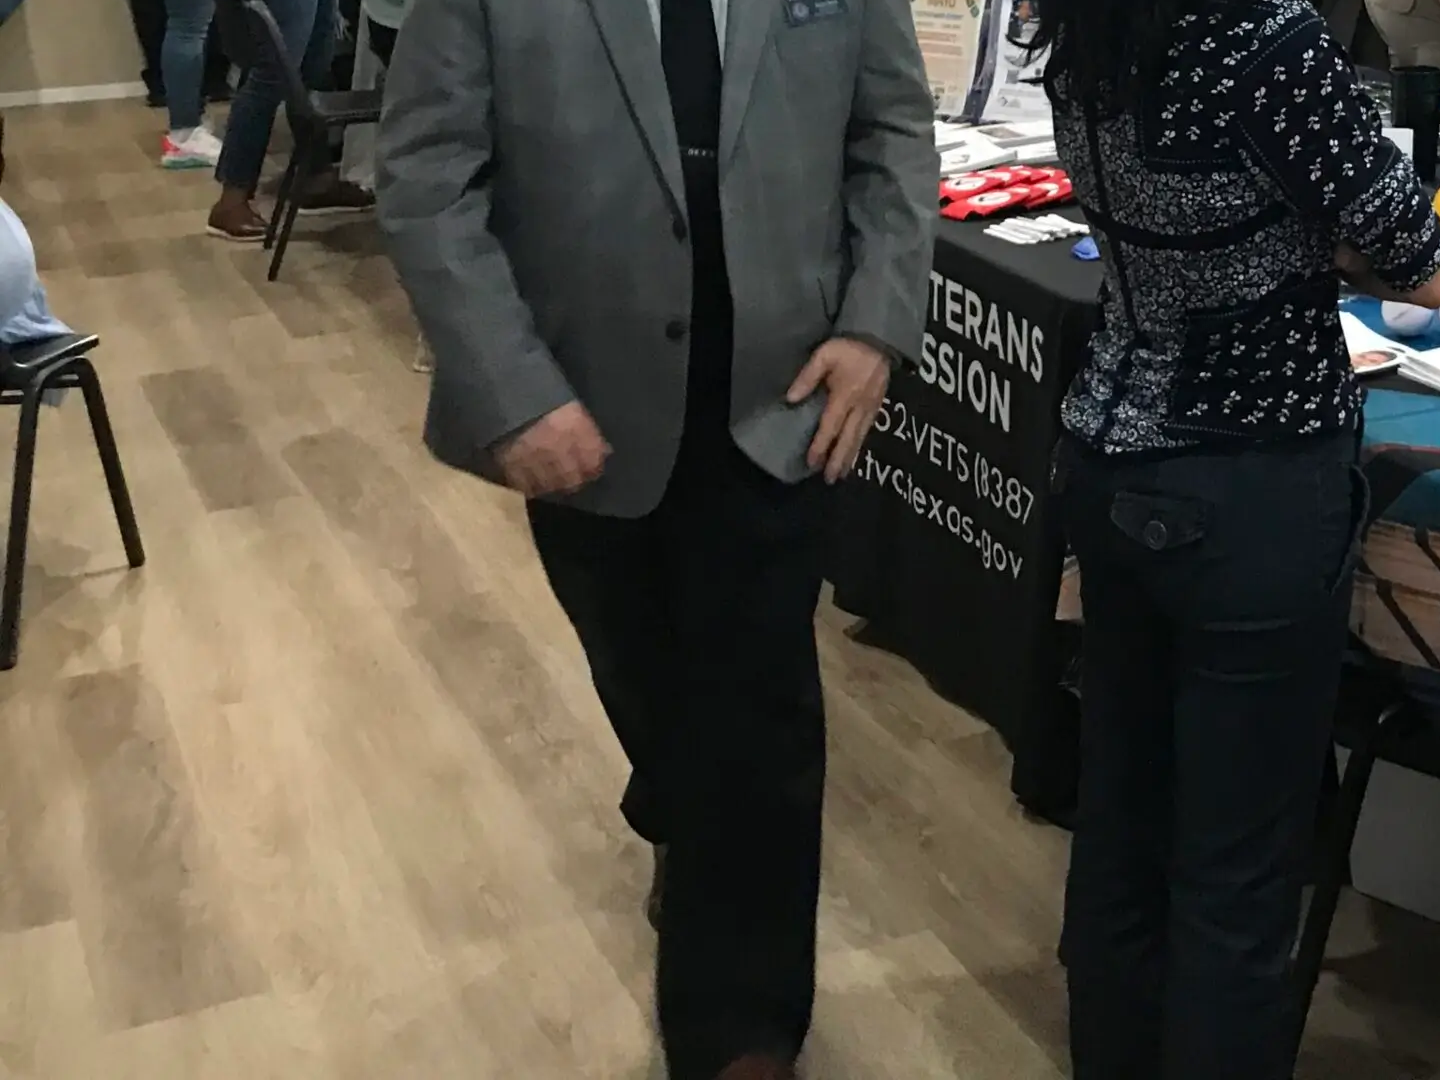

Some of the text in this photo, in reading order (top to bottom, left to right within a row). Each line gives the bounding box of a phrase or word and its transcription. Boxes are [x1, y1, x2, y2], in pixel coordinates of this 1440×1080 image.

[919, 332, 1011, 432] SSION
[929, 269, 1044, 383] TERANS
[852, 449, 1023, 580] .tvc.texas.gov
